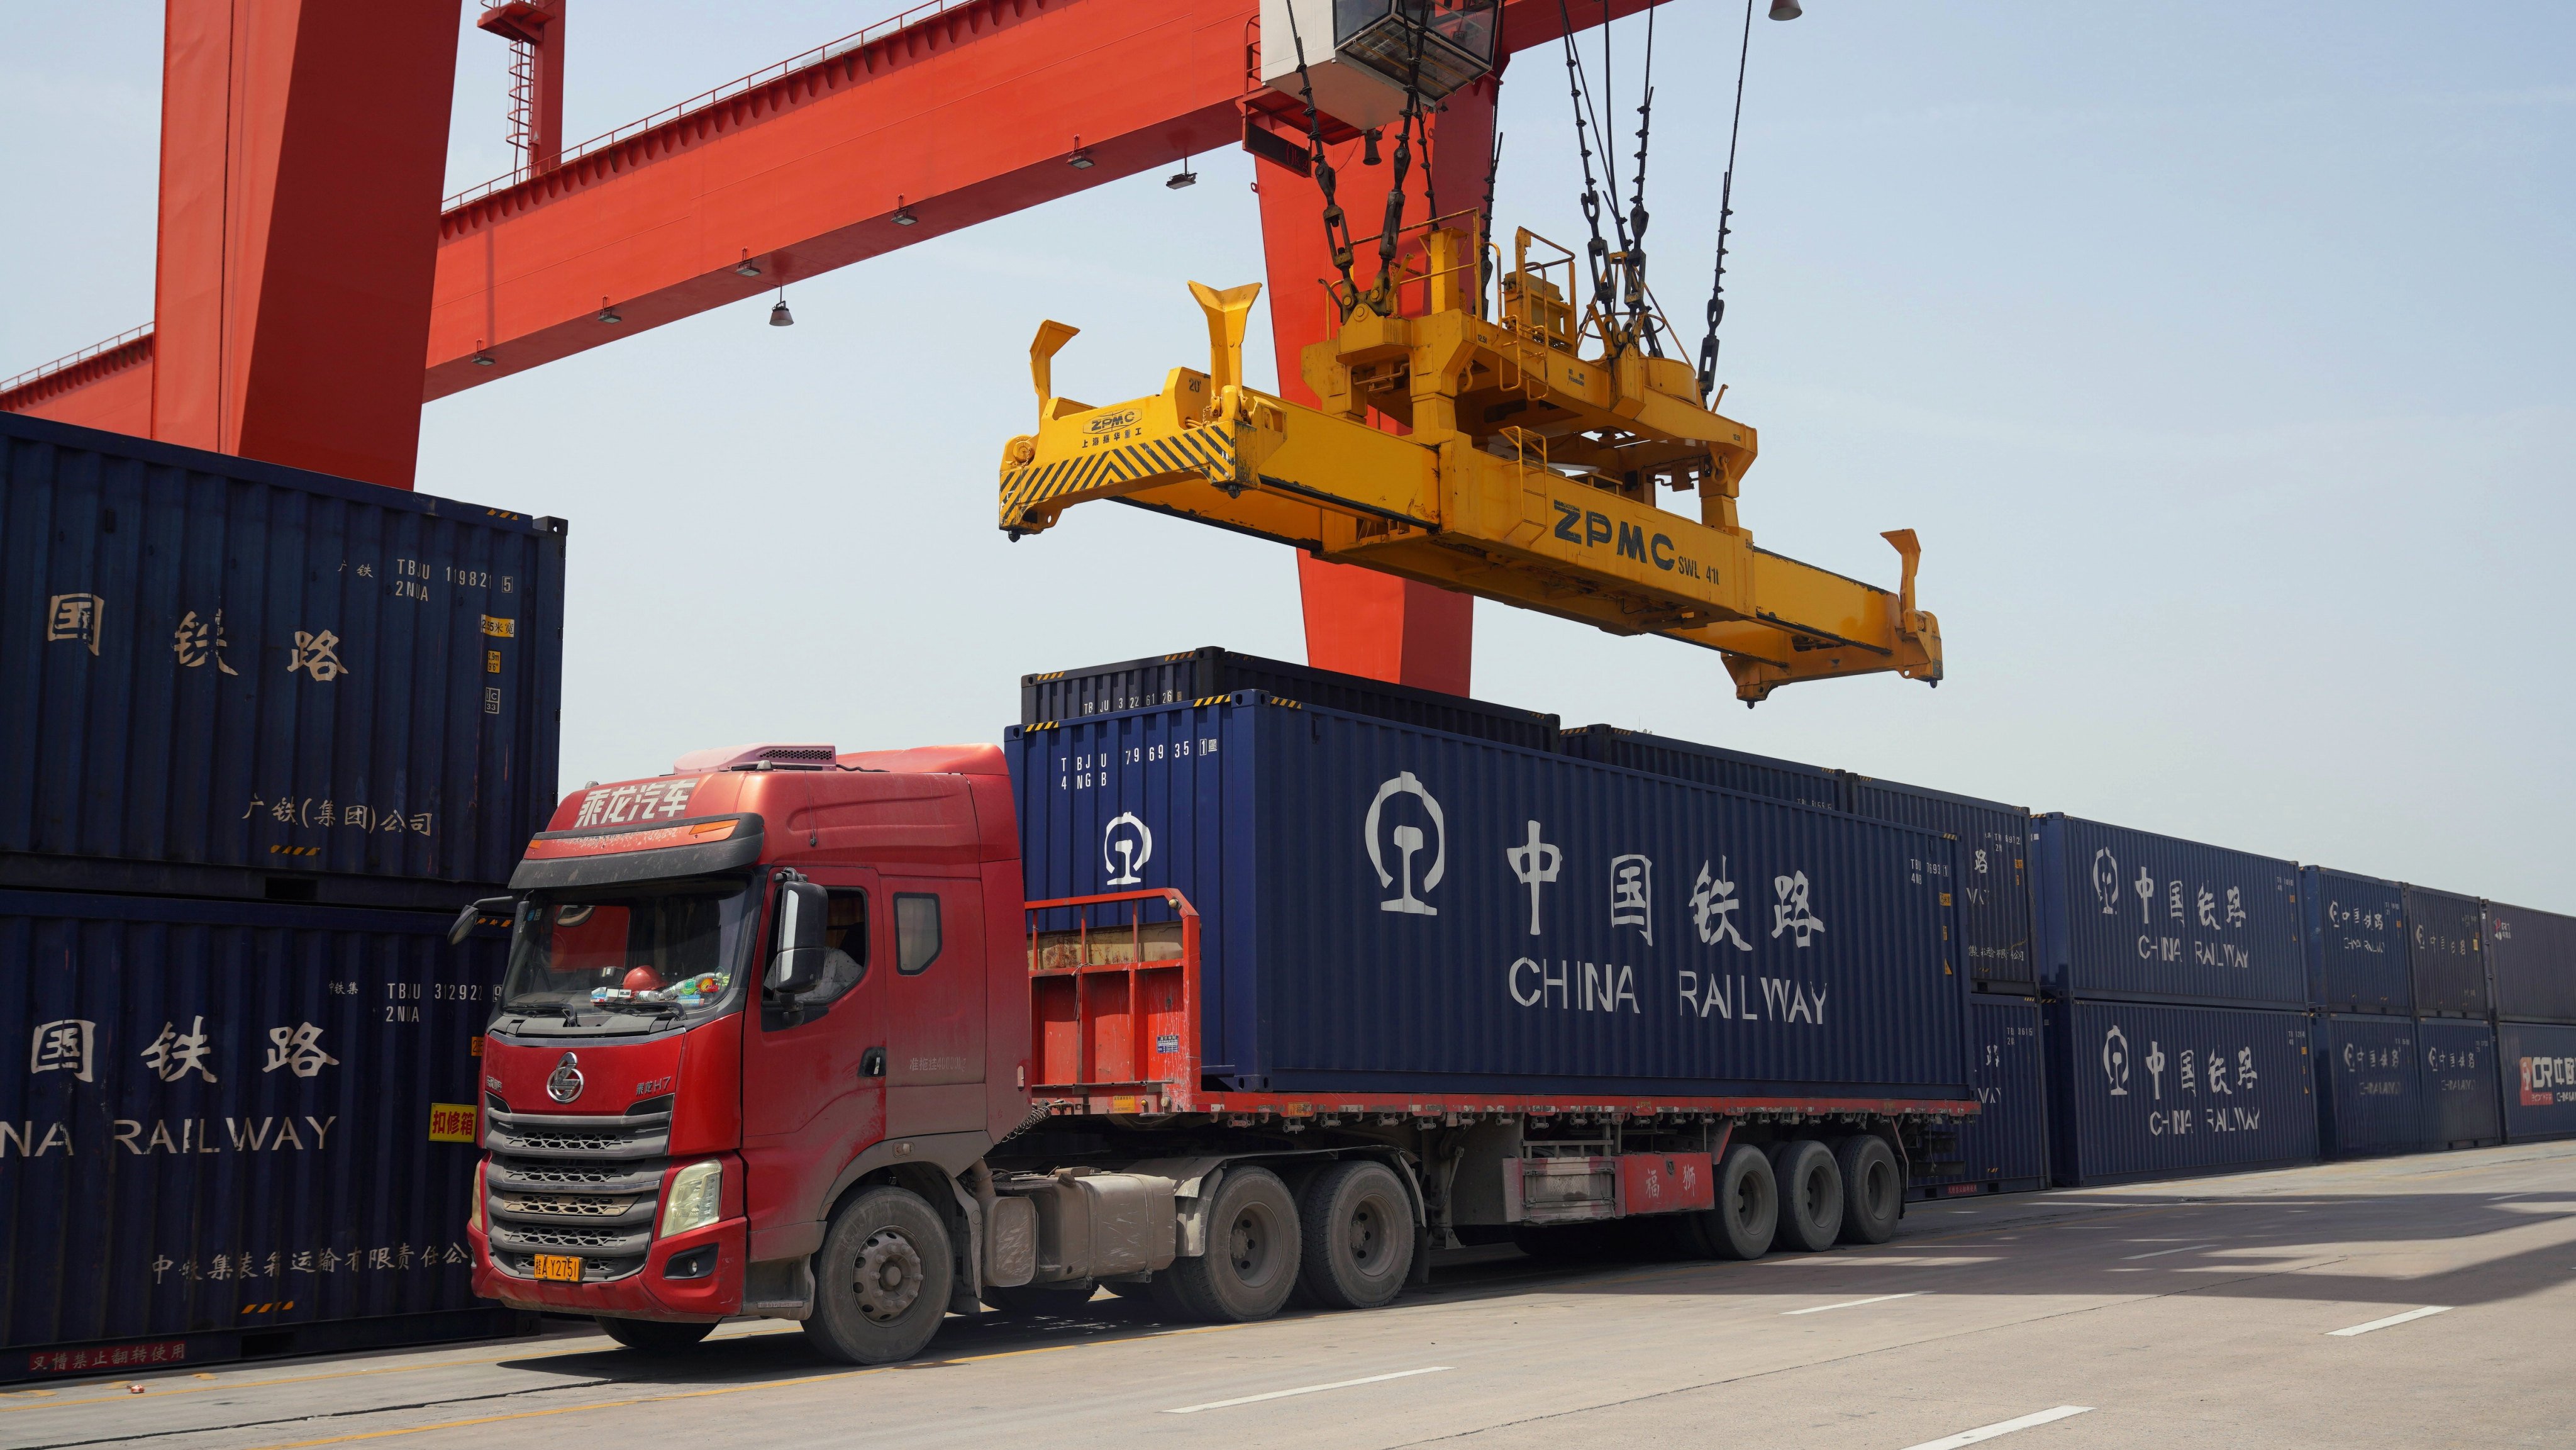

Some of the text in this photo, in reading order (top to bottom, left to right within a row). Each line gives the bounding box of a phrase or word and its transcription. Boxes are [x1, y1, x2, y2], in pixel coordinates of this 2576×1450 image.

[1091, 411, 1135, 431] ZPMC
[1082, 428, 1141, 448] 上海振华重工
[1553, 499, 1675, 571] ZPMC
[1678, 556, 1700, 579] SWL
[396, 581, 428, 601] 2NUA
[397, 559, 512, 592] TBJU 119821 5
[48, 593, 348, 681] 国铁路
[1061, 740, 1206, 772] TBJU 796935 1
[1061, 772, 1107, 789] 4NGB
[242, 793, 432, 836] 广铁(集团)公司
[574, 780, 696, 828] 乘龙汽车
[1507, 820, 1825, 951] 中国铁路
[2136, 866, 2246, 930] 中国铁路
[2138, 935, 2248, 968] CHINA RAILWAY
[387, 983, 421, 1000] TBJU
[435, 983, 482, 1001] 312922
[1509, 957, 1826, 1024] CHINA RAILWAY
[30, 1015, 340, 1083] 国铁路
[2146, 1041, 2257, 1100] 中国铁路
[2532, 1057, 2553, 1088] CR
[114, 1116, 336, 1155] RAILWAY
[433, 1110, 474, 1136] 扣修箱
[2149, 1107, 2260, 1135] CHINA RAILWAY
[1646, 1164, 1696, 1198] 福狮
[31, 1344, 185, 1371] 叉槽禁止翻转使用
